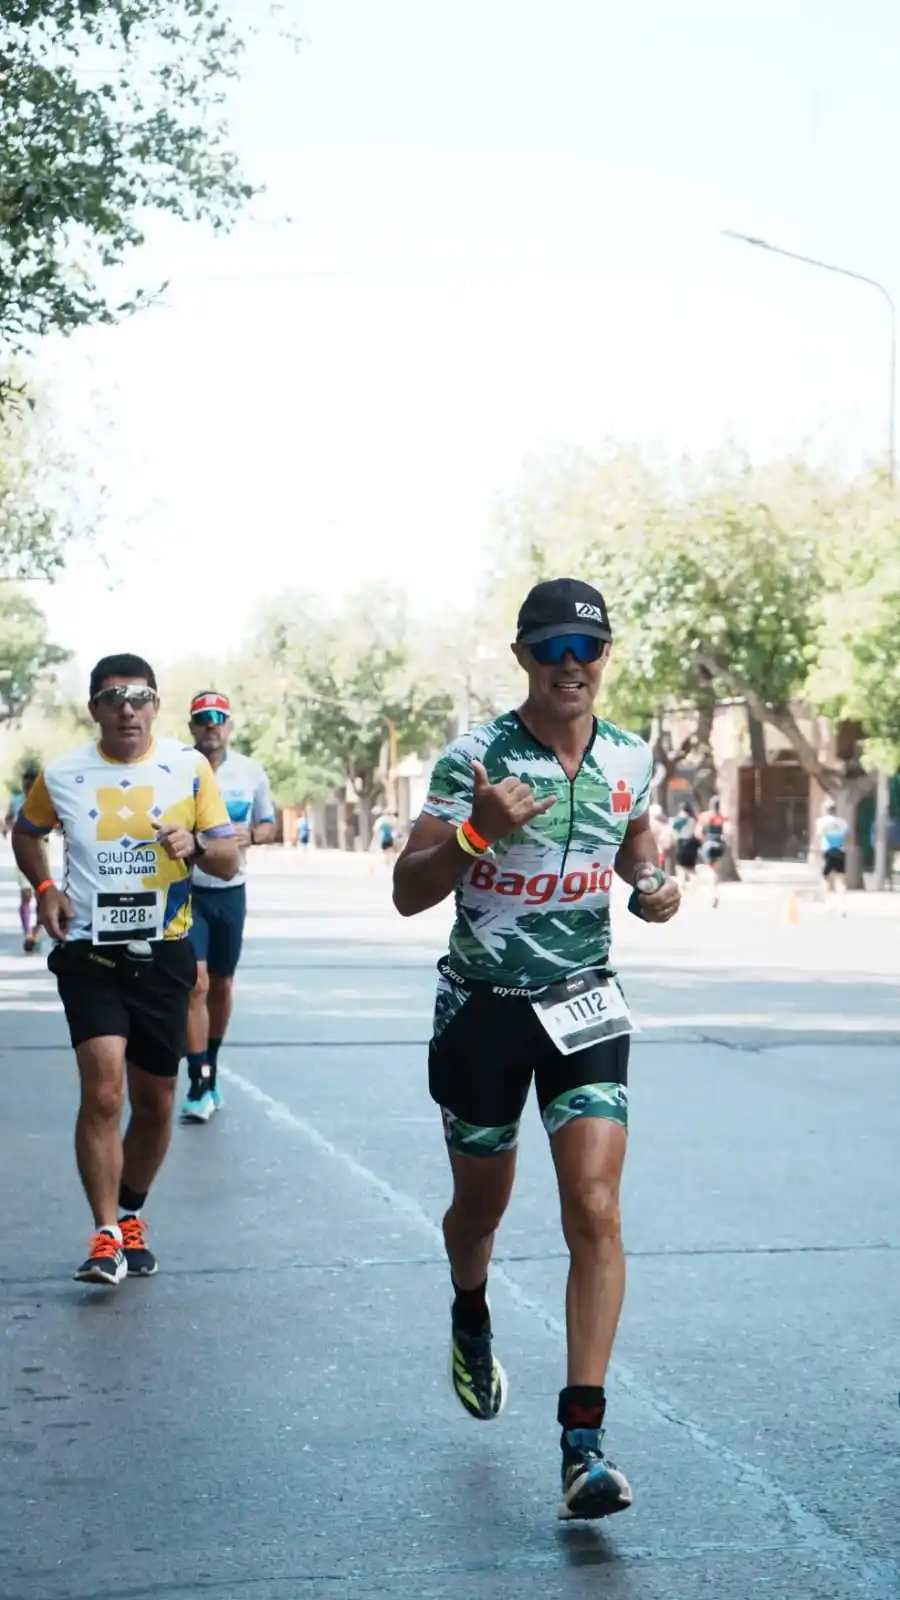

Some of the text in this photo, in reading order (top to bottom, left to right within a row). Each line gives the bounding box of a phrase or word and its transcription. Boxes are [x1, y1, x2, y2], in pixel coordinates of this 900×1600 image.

[97, 851, 156, 863] CIUDAD
[98, 864, 156, 875] San Juan
[470, 859, 613, 905] Baggio
[110, 908, 146, 924] 2028
[565, 992, 607, 1021] 1112
